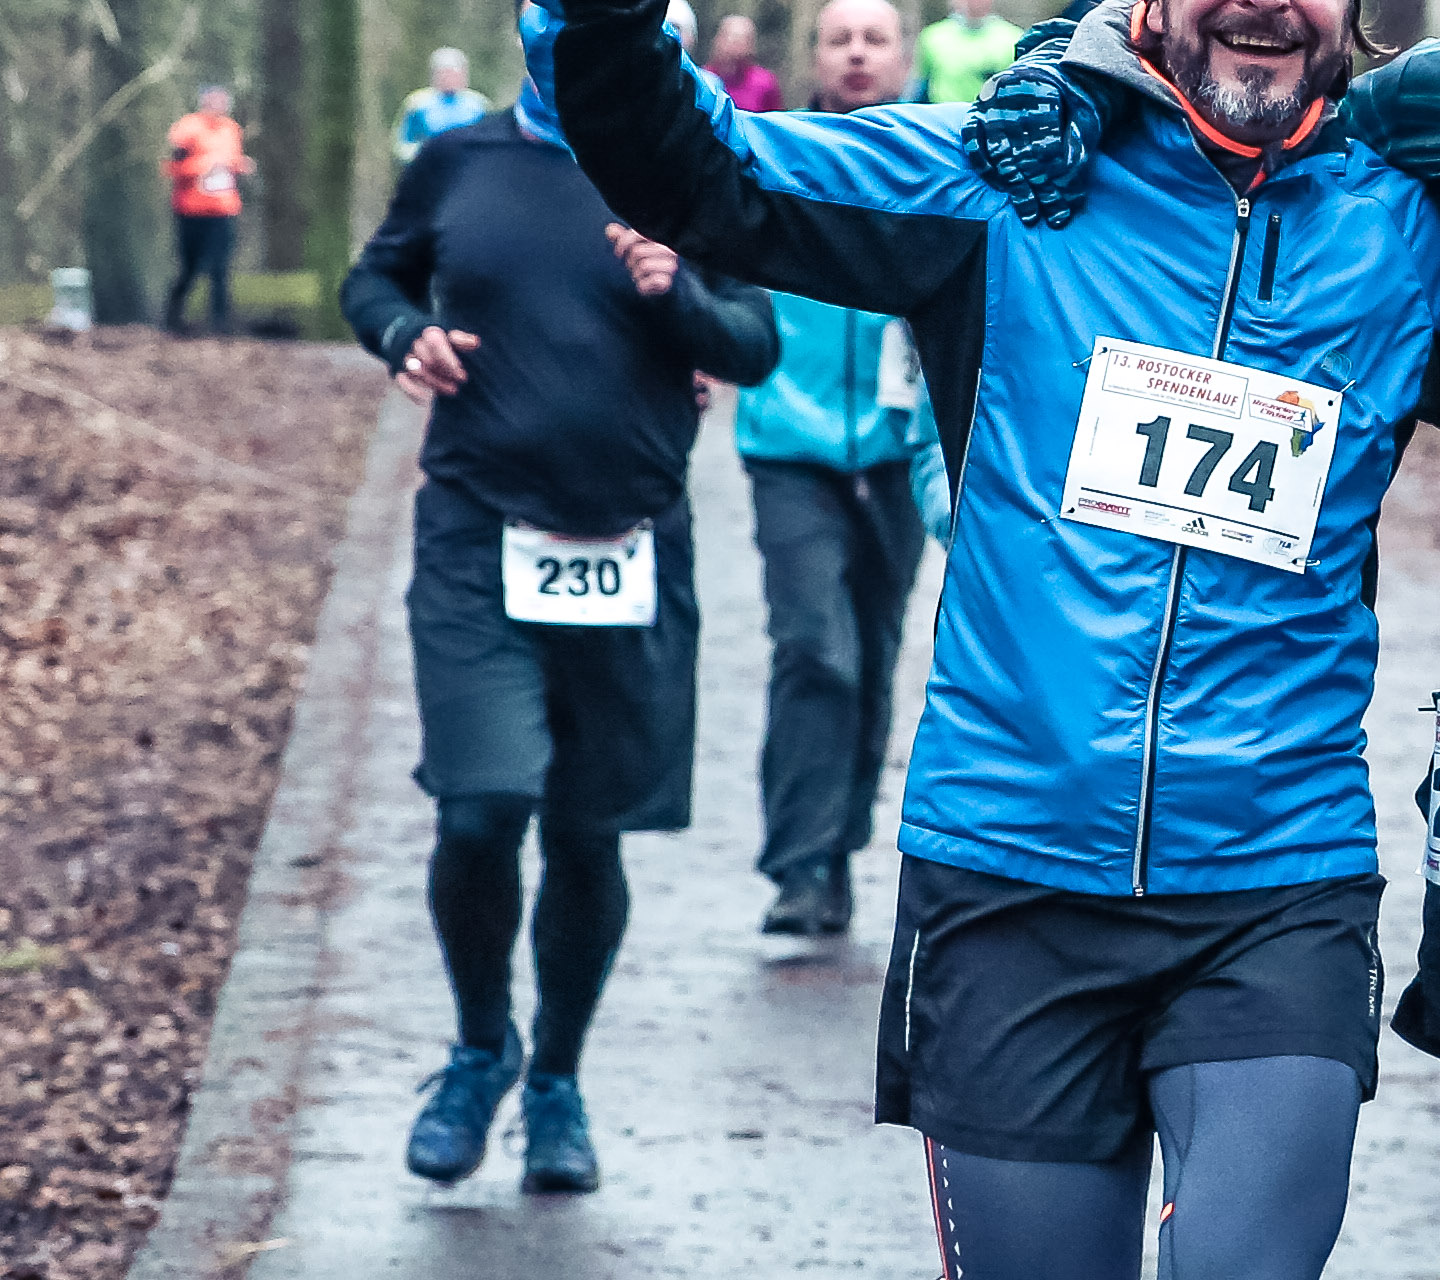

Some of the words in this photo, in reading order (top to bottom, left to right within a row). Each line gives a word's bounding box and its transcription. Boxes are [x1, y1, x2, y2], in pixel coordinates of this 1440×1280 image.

[1113, 354, 1131, 369] 13.
[1137, 358, 1212, 384] ROSTOCKER
[1146, 377, 1239, 407] SPENDENLAUF
[1135, 415, 1279, 514] 174
[536, 558, 620, 596] 230
